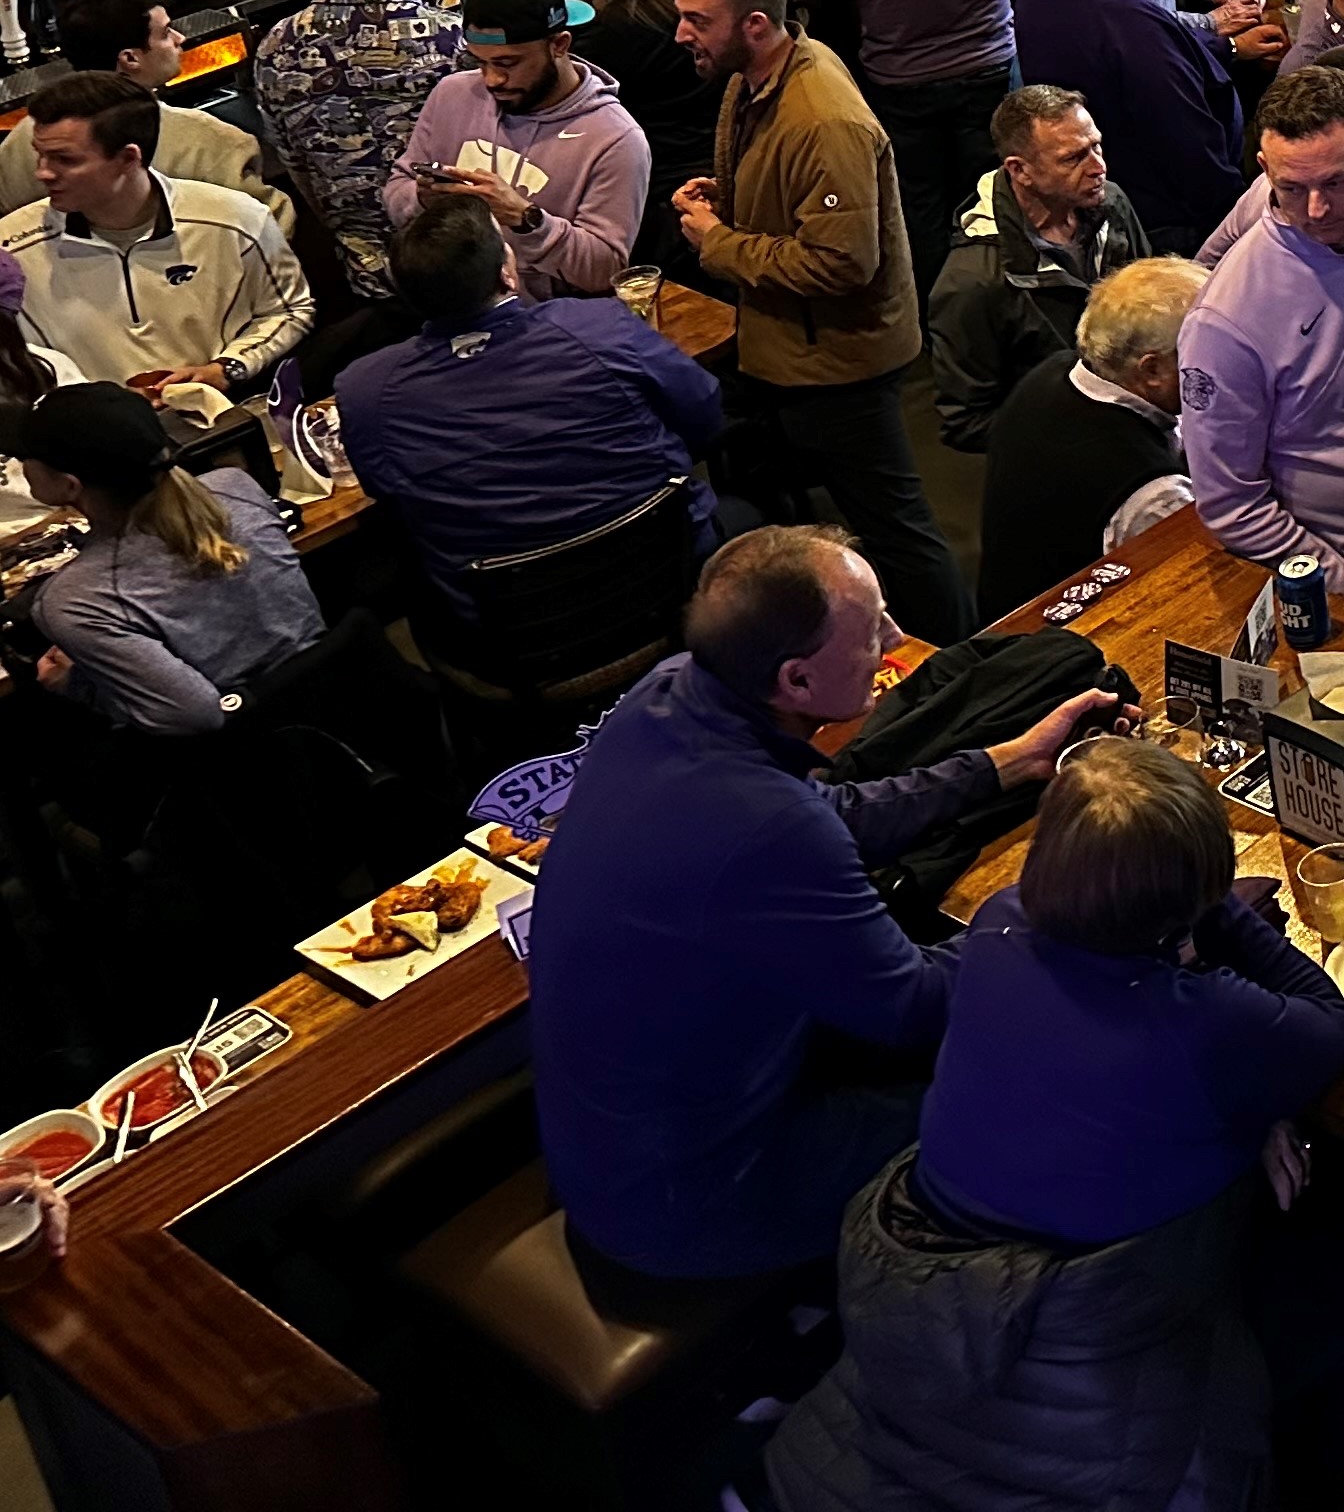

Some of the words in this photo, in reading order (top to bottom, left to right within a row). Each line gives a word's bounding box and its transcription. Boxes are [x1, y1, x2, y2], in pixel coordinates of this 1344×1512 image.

[1280, 599, 1302, 616] UD
[1280, 611, 1311, 629] GHT
[497, 753, 582, 810] STAT
[1278, 741, 1341, 800] STORE
